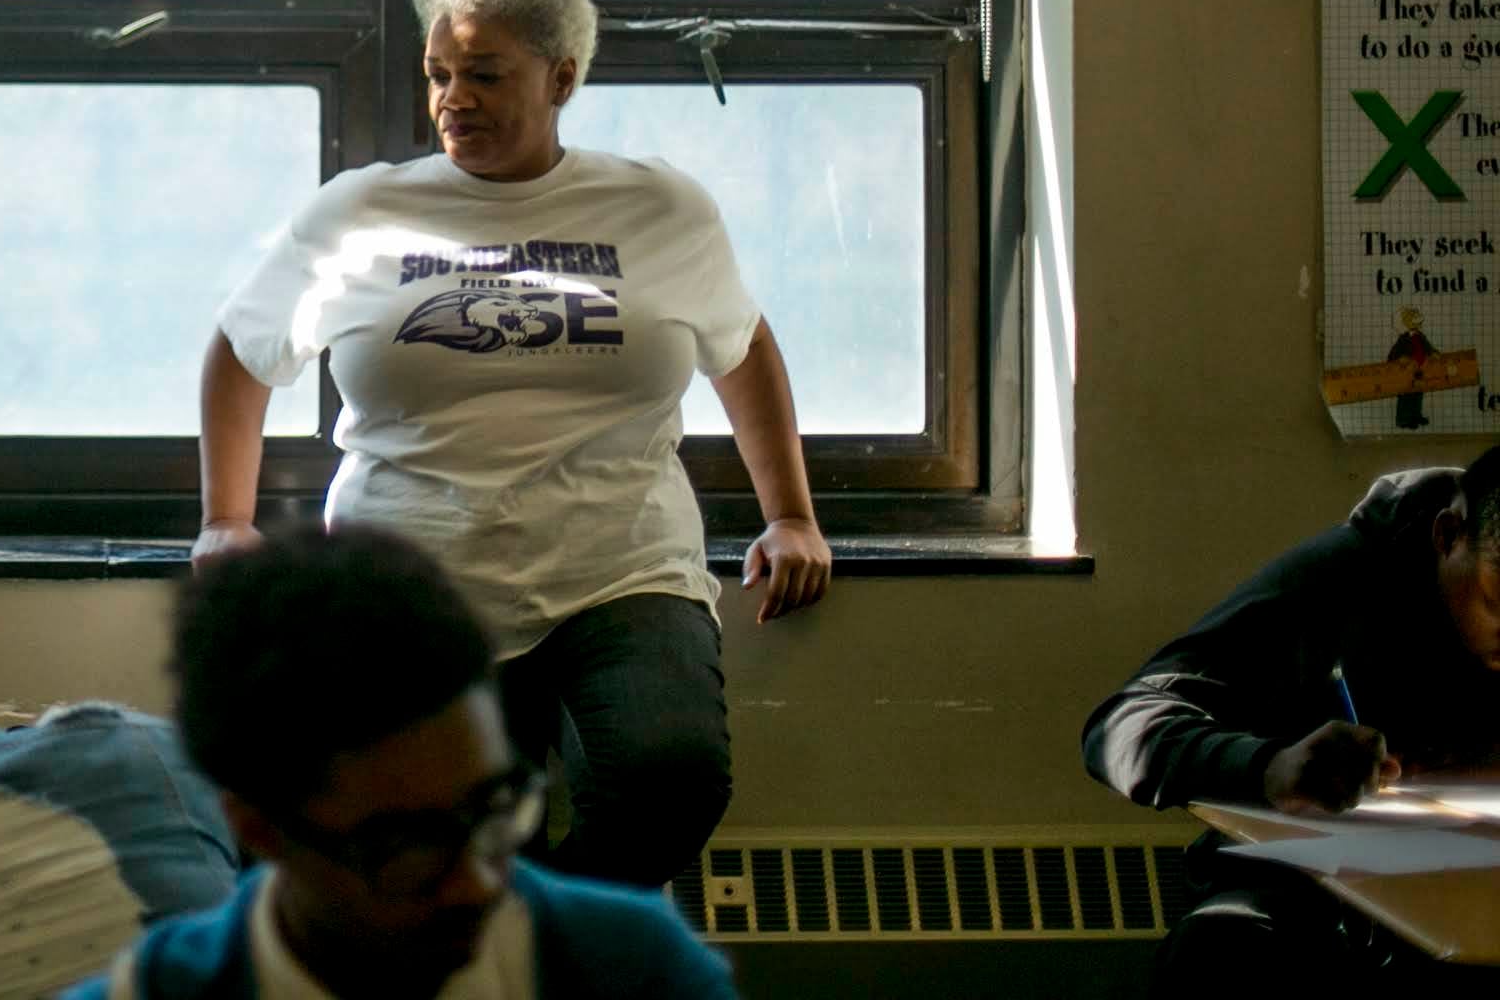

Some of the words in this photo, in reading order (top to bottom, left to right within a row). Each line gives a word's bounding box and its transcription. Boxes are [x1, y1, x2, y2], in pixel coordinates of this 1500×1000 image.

[1361, 33, 1388, 60] to
[1397, 34, 1431, 59] do
[1440, 40, 1452, 58] a
[1360, 230, 1424, 265] They
[1434, 230, 1495, 258] seek
[460, 278, 511, 289] FIELD
[1376, 268, 1404, 296] to
[1413, 266, 1465, 294] find
[1475, 275, 1488, 294] a
